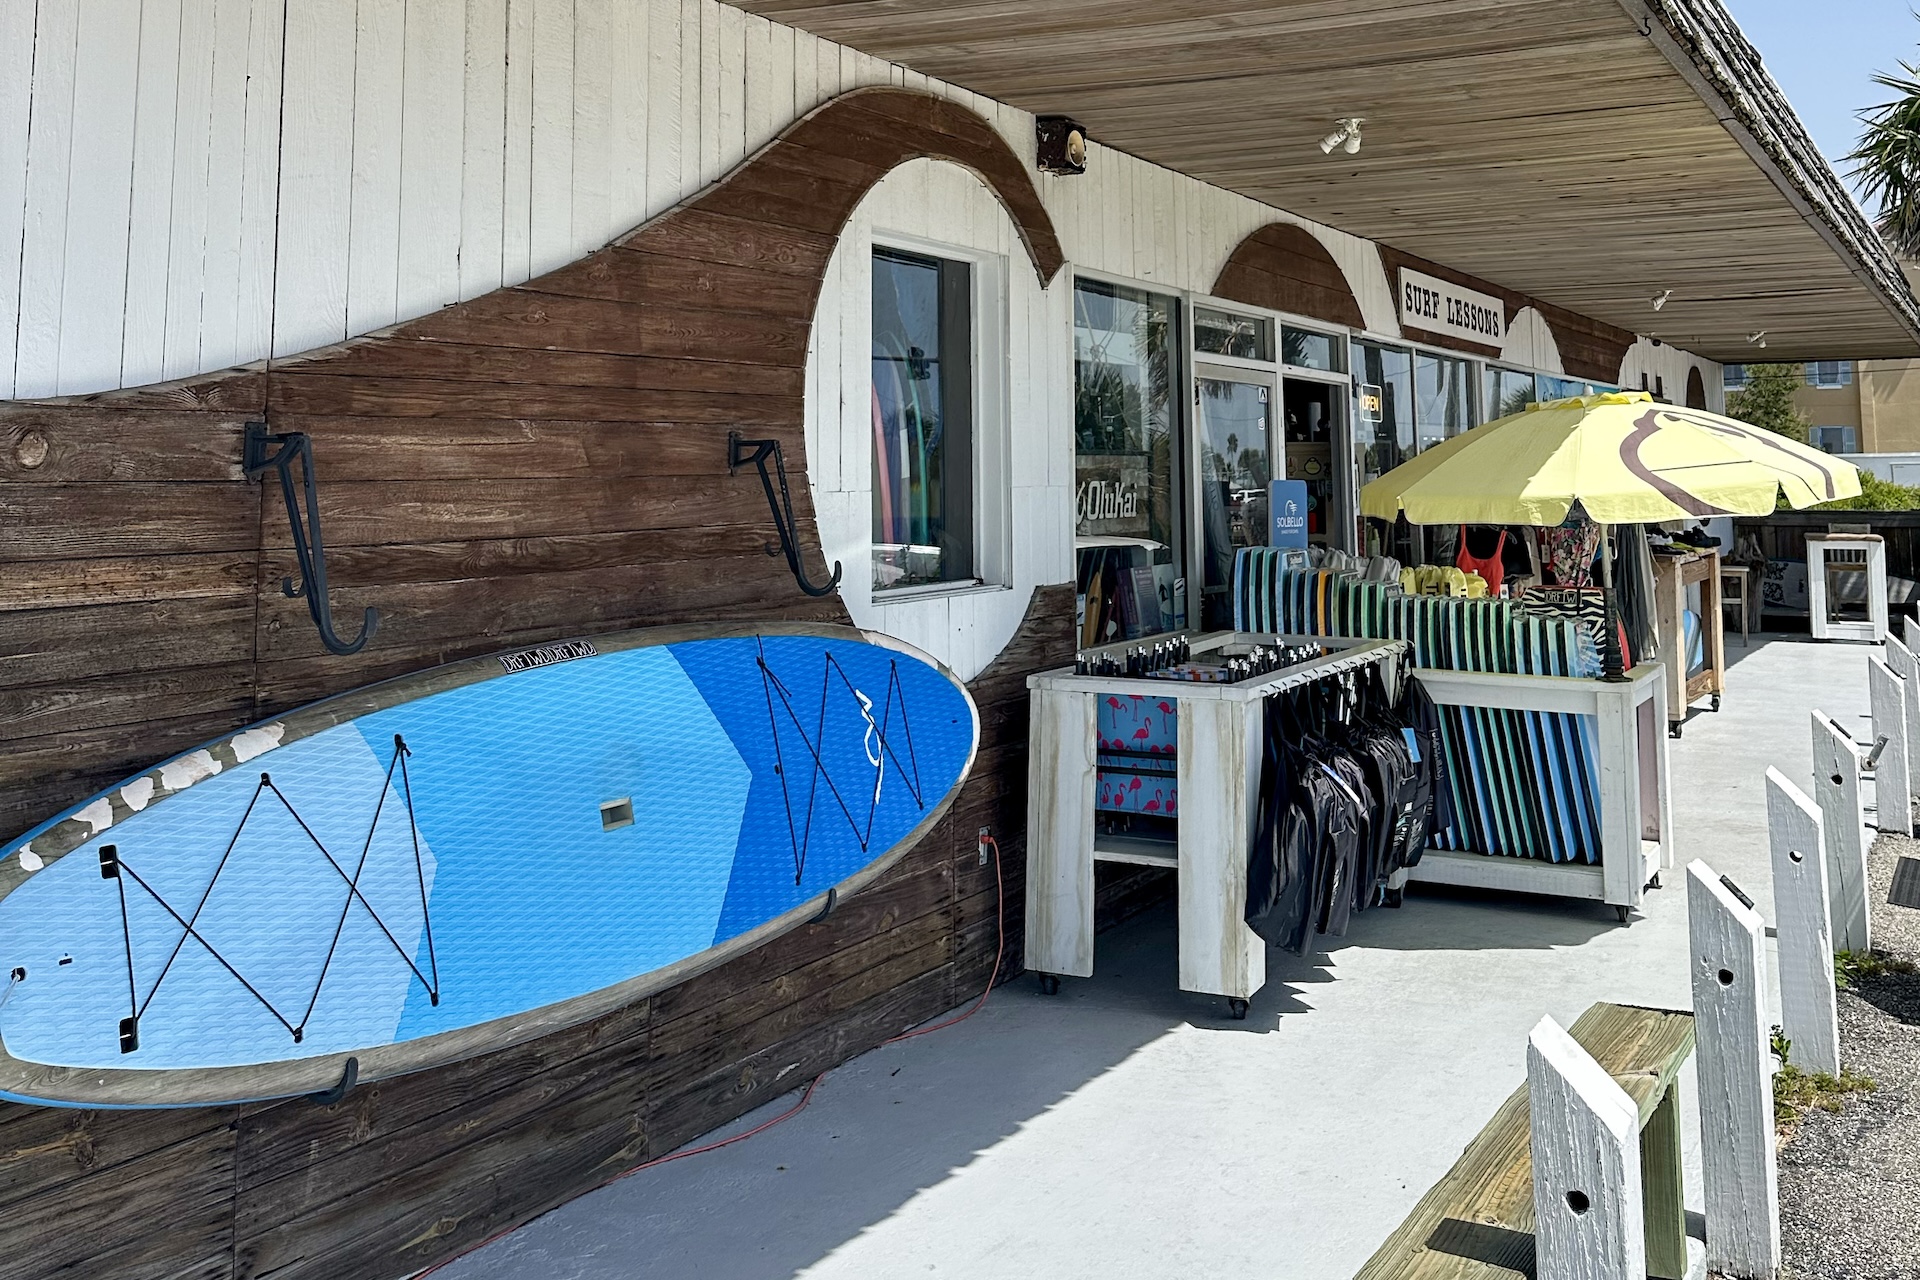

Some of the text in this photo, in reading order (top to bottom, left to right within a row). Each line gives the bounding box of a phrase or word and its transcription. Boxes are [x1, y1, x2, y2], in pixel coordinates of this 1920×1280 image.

[1405, 281, 1499, 338] SURF LESSONS
[1362, 394, 1380, 412] OPEN
[1087, 480, 1138, 520] OluKai
[1276, 516, 1304, 528] SOLBELLO
